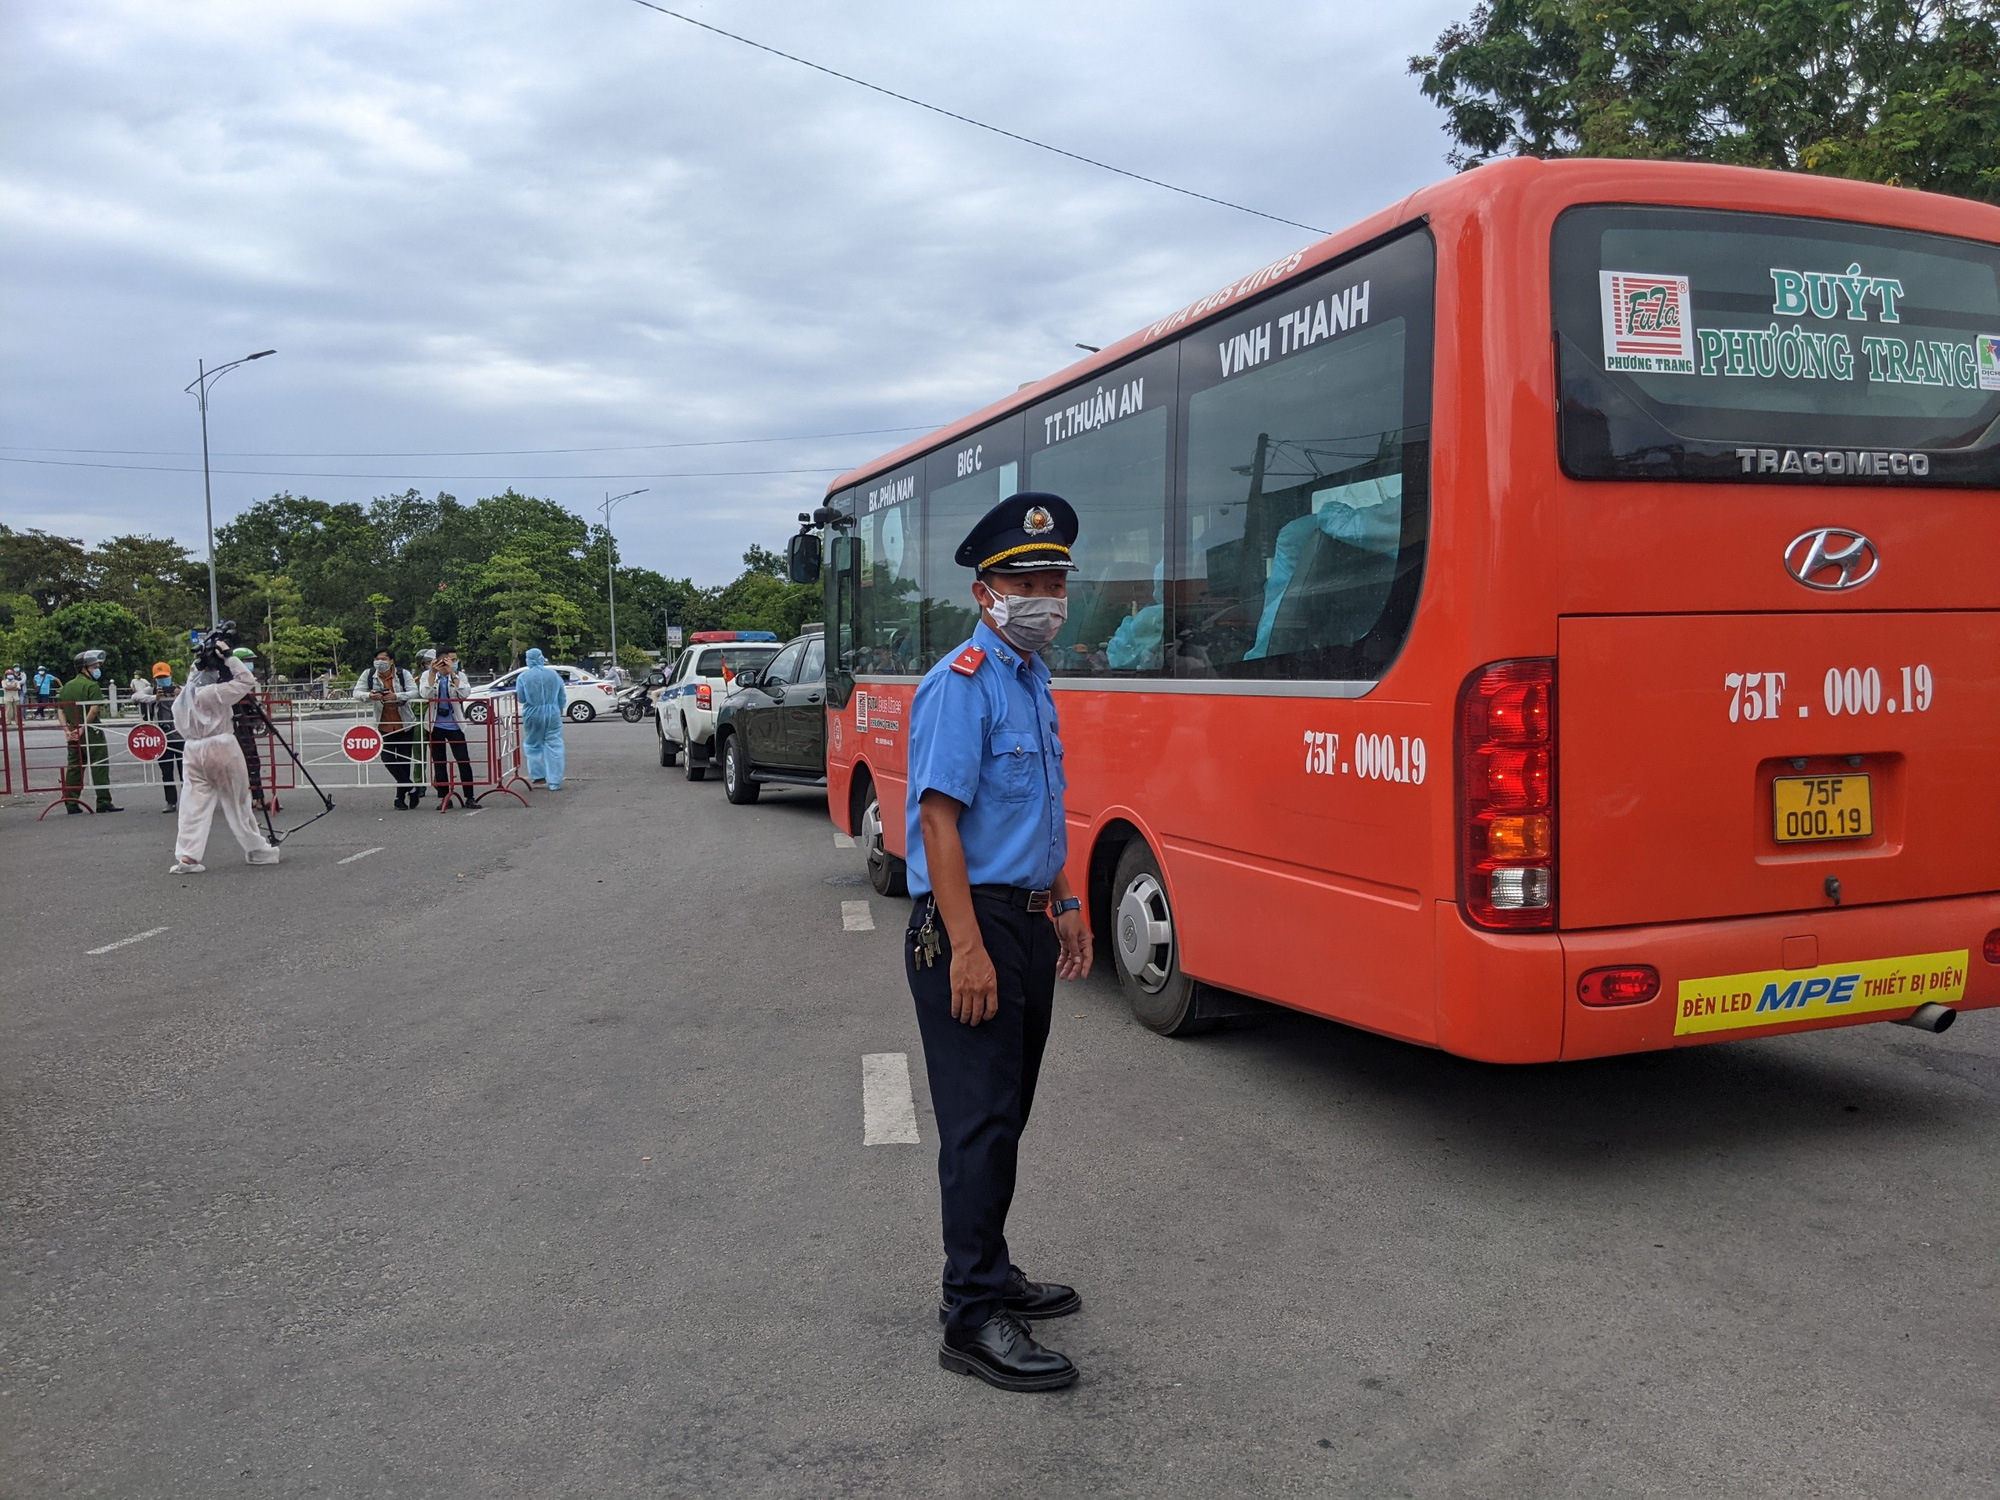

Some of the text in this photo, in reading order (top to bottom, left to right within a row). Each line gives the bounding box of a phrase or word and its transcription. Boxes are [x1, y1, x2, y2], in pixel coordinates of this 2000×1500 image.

[1770, 262, 1904, 323] BUÝT
[1219, 280, 1370, 377] VINH THANH
[1607, 355, 1692, 372] PHƯƠNG TRANG
[1697, 322, 1977, 389] PHƯƠNG TRANG
[1045, 377, 1143, 445] TT.THUẬN AN
[958, 445, 982, 477] BIG C
[1735, 449, 1929, 476] TRACOMECO
[897, 476, 914, 502] NAM
[133, 736, 160, 749] STOP
[347, 738, 378, 750] STOP
[1802, 779, 1843, 806] 75F
[1786, 808, 1861, 836] 000.19
[1682, 966, 1962, 1018] ĐÈN LED MPE THIẾT BỊ ĐIỆN
